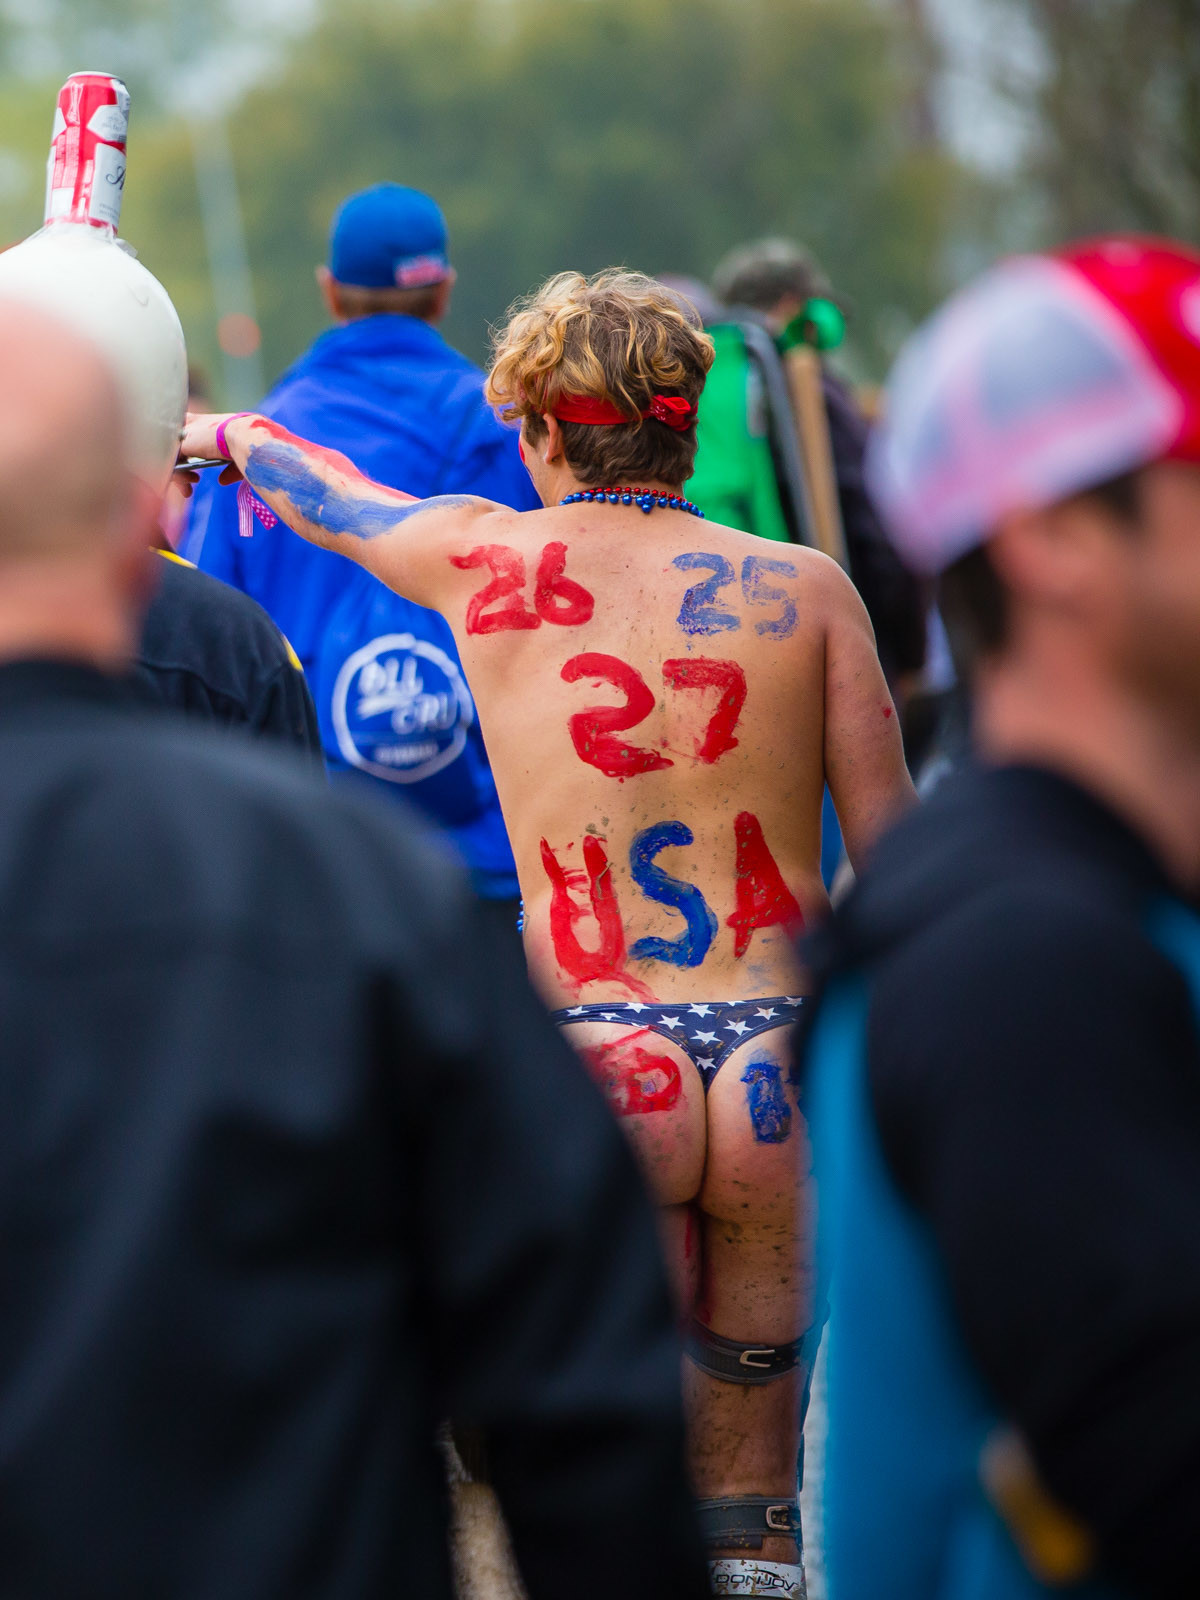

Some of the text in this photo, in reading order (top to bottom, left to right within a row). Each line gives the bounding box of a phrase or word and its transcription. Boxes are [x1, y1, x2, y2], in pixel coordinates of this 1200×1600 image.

[449, 541, 799, 641] 26 25
[560, 652, 748, 778] 27
[540, 811, 804, 984] USA
[716, 1574, 799, 1592] DONJOY
